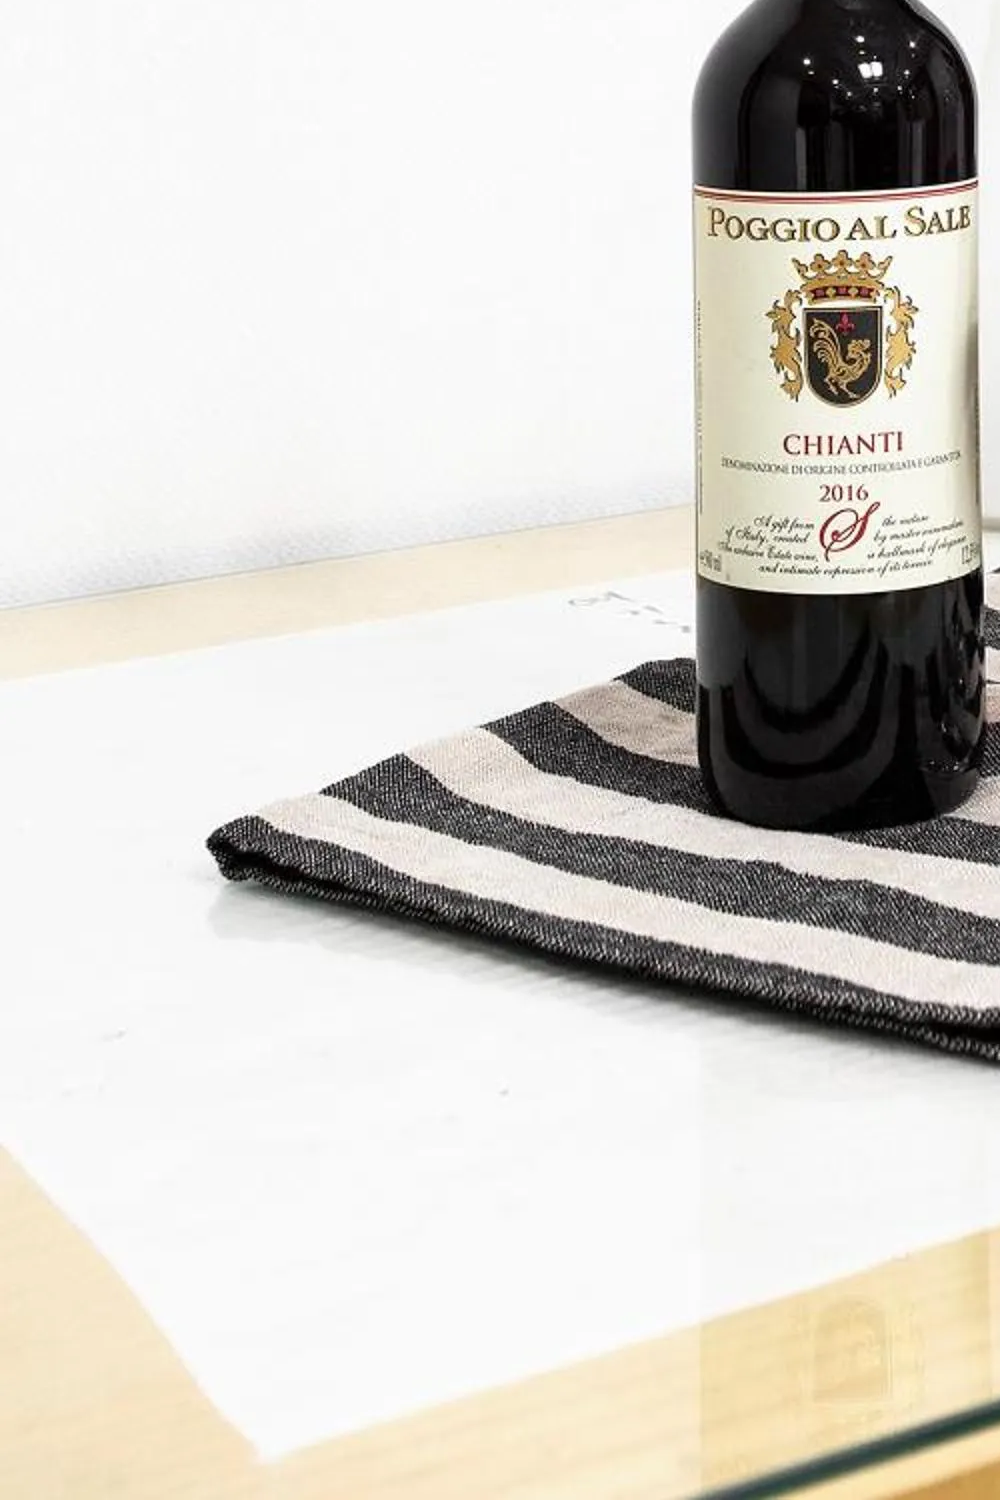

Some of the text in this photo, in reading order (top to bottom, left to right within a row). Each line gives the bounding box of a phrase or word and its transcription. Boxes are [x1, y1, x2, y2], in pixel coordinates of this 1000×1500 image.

[708, 205, 970, 242] POGGIO AL SALE
[783, 431, 903, 456] CHIANTI
[818, 483, 869, 503] 2016
[771, 517, 790, 533] gift
[789, 520, 815, 534] from
[881, 515, 896, 527] the
[873, 531, 888, 546] by
[759, 562, 778, 574] and
